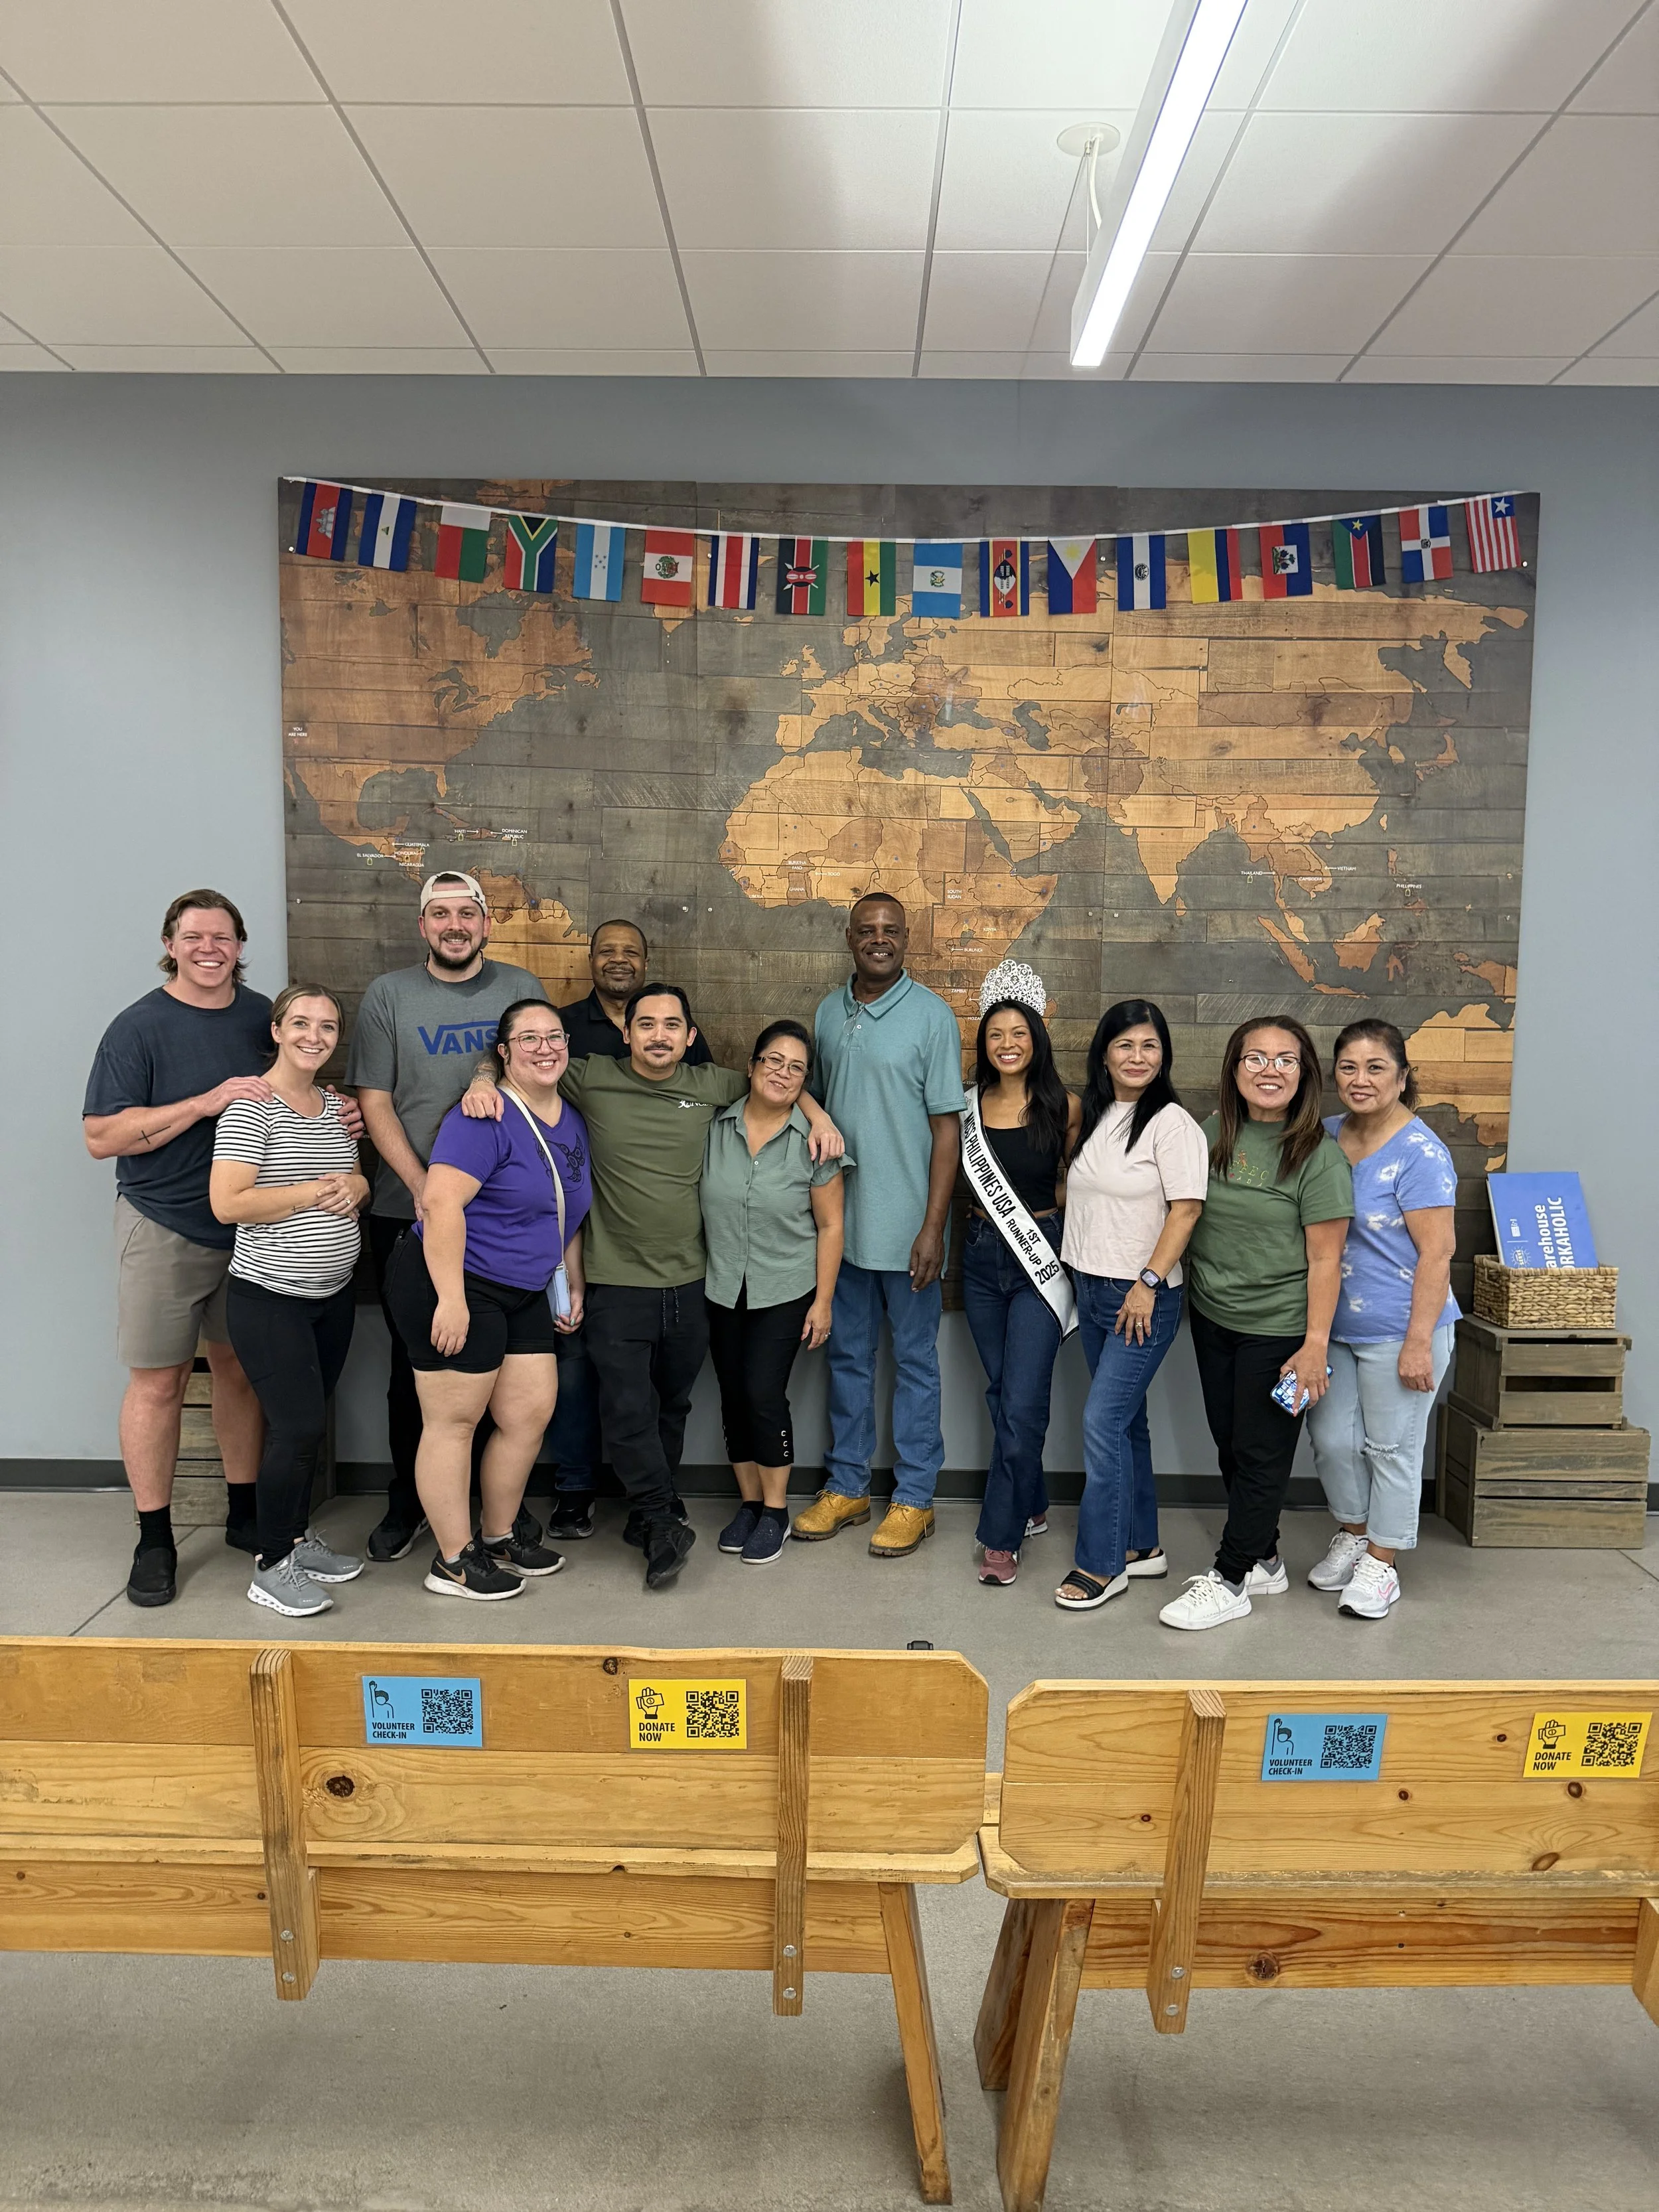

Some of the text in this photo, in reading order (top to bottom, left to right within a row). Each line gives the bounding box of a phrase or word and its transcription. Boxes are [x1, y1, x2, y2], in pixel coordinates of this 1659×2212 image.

[964, 1111, 1017, 1218] MISS PHILIPPINES USA
[1026, 1228, 1041, 1245] 1ST
[1534, 1205, 1557, 1268] arehouse
[1547, 1197, 1575, 1268] RKAHOLIC
[1006, 1218, 1042, 1266] RUNNER-UP
[1035, 1260, 1060, 1286] 2025
[372, 1722, 415, 1731] VOLUNTEER
[638, 1722, 676, 1732] DONATE
[372, 1730, 407, 1739] CHECK-IN
[639, 1732, 662, 1741] NOW
[1534, 1751, 1572, 1761] DONATE
[1532, 1761, 1557, 1771] NOW
